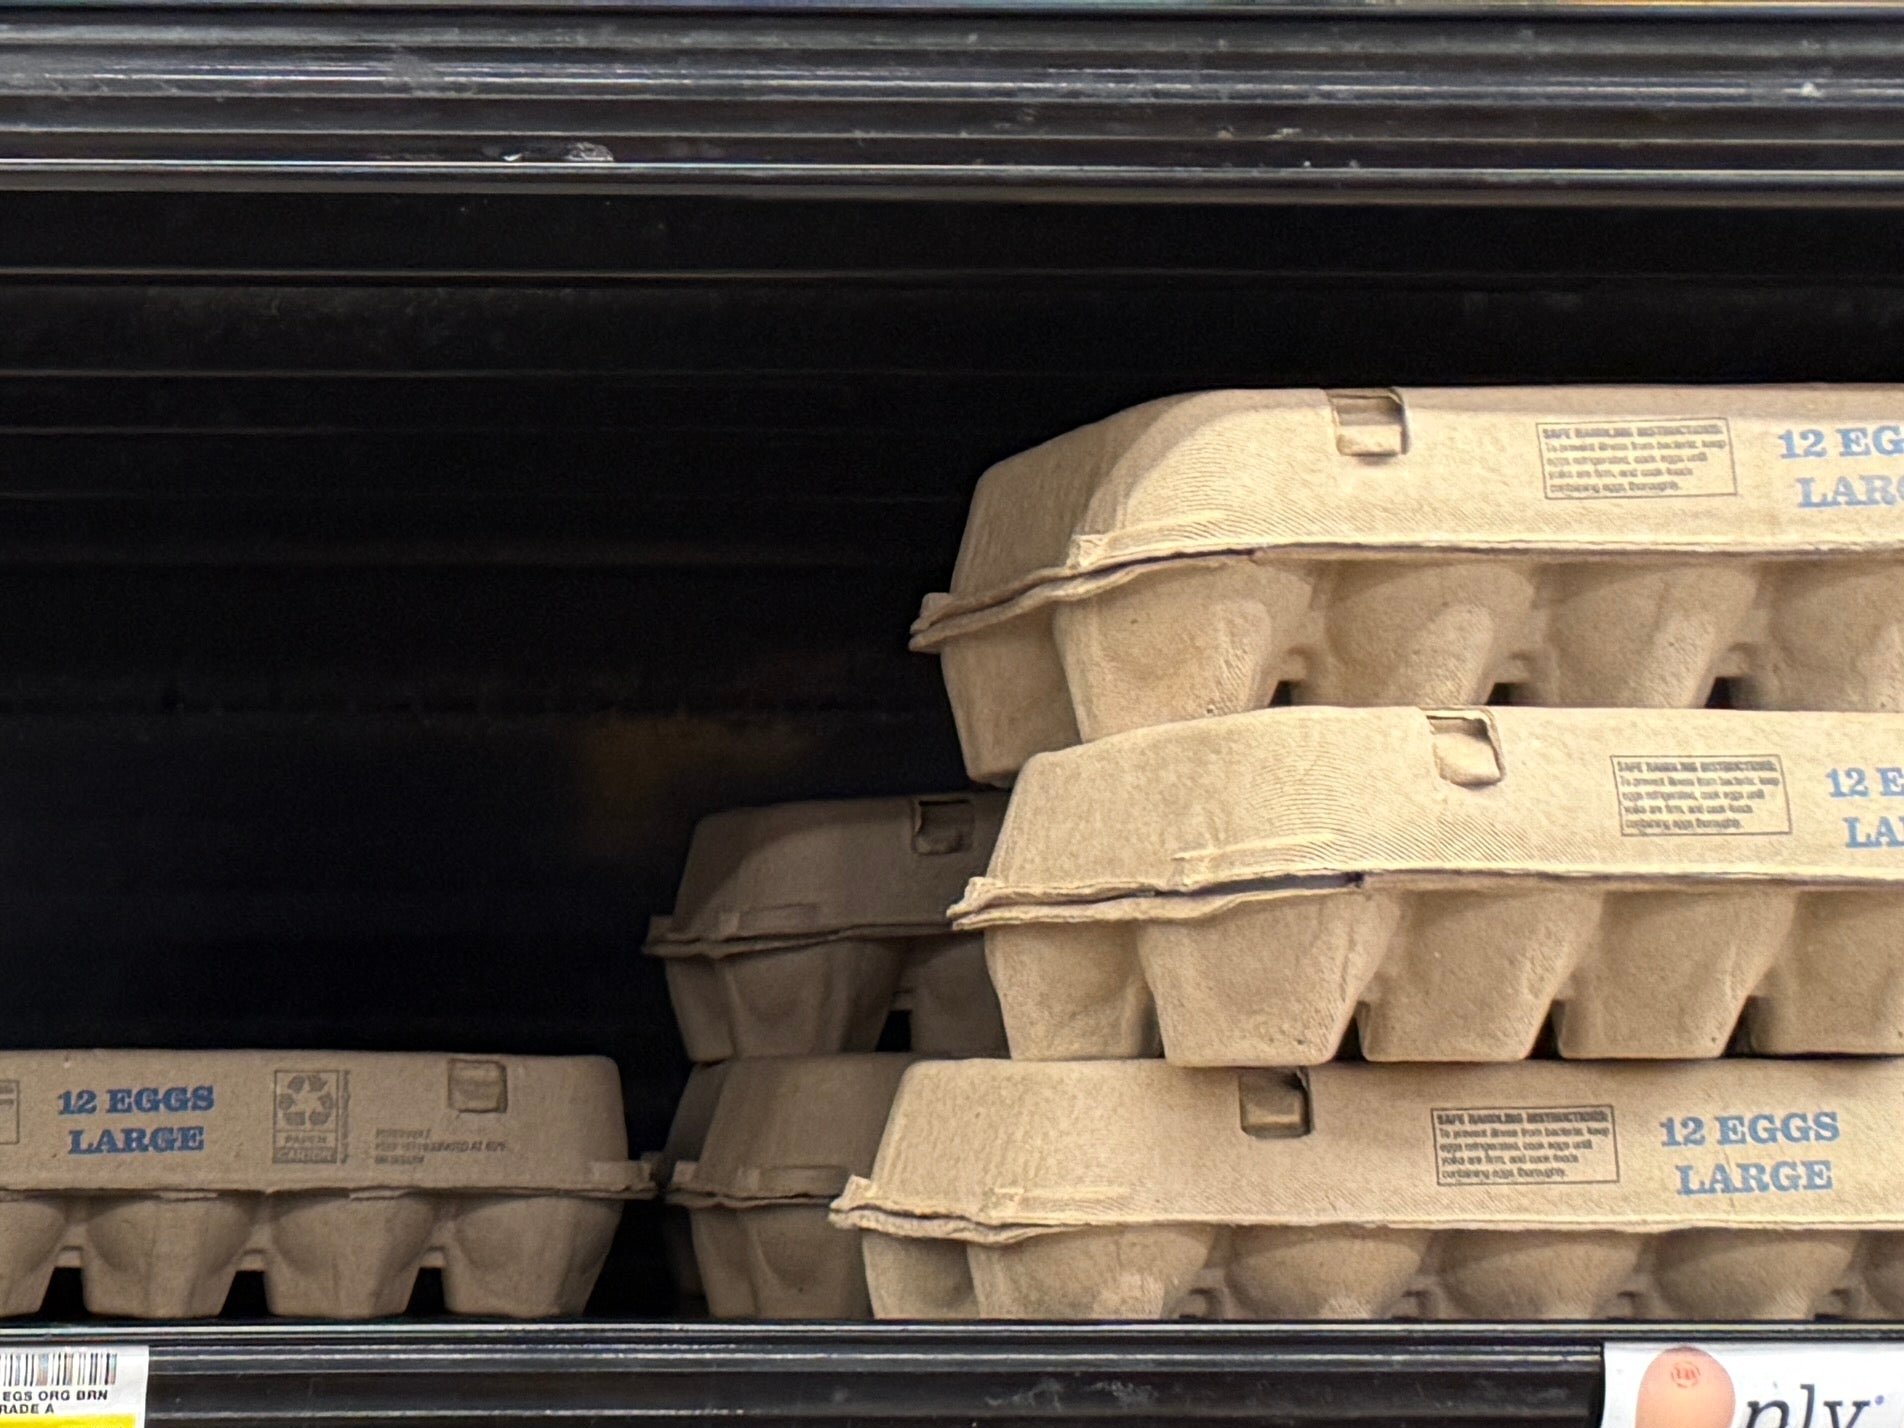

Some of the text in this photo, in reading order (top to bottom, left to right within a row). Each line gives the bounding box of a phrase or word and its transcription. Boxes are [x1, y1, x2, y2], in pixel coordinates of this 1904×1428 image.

[58, 1085, 214, 1115] 12 EGGS
[68, 1126, 205, 1154] LARGE
[1660, 1112, 1840, 1147] 12 EGGS
[1676, 1160, 1834, 1196] LARGE
[45, 1404, 55, 1414] A
